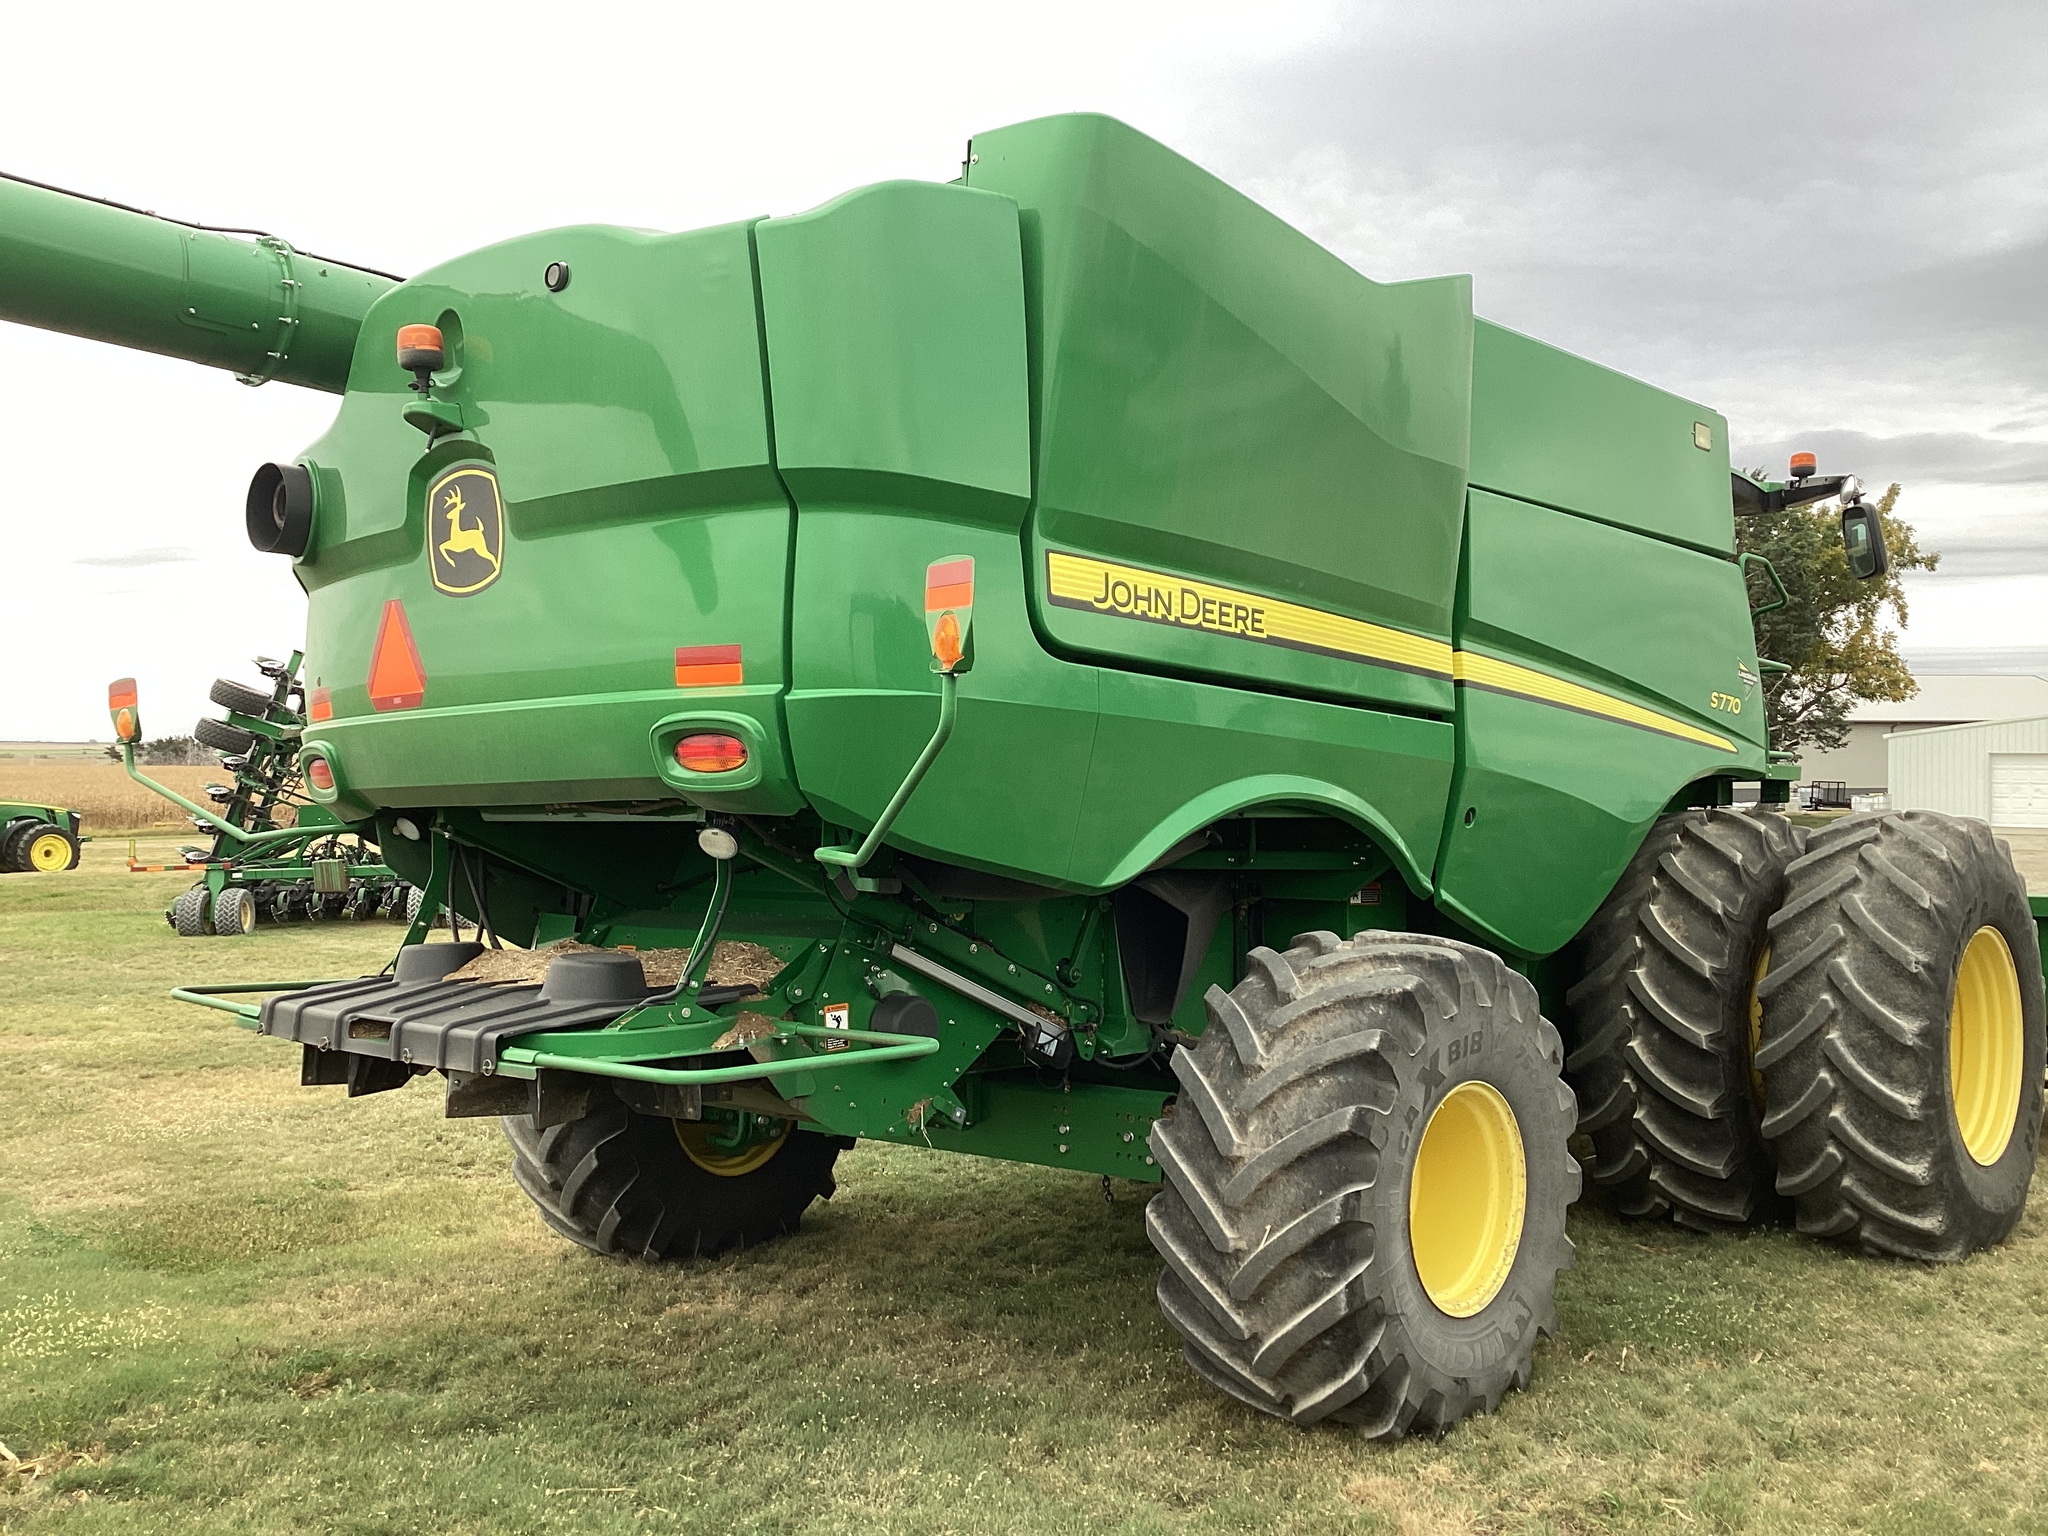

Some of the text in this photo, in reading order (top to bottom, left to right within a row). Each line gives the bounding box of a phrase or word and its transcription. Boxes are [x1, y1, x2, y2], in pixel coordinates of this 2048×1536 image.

[1093, 571, 1265, 634] JOHN DEERE
[1710, 691, 1741, 715] S770
